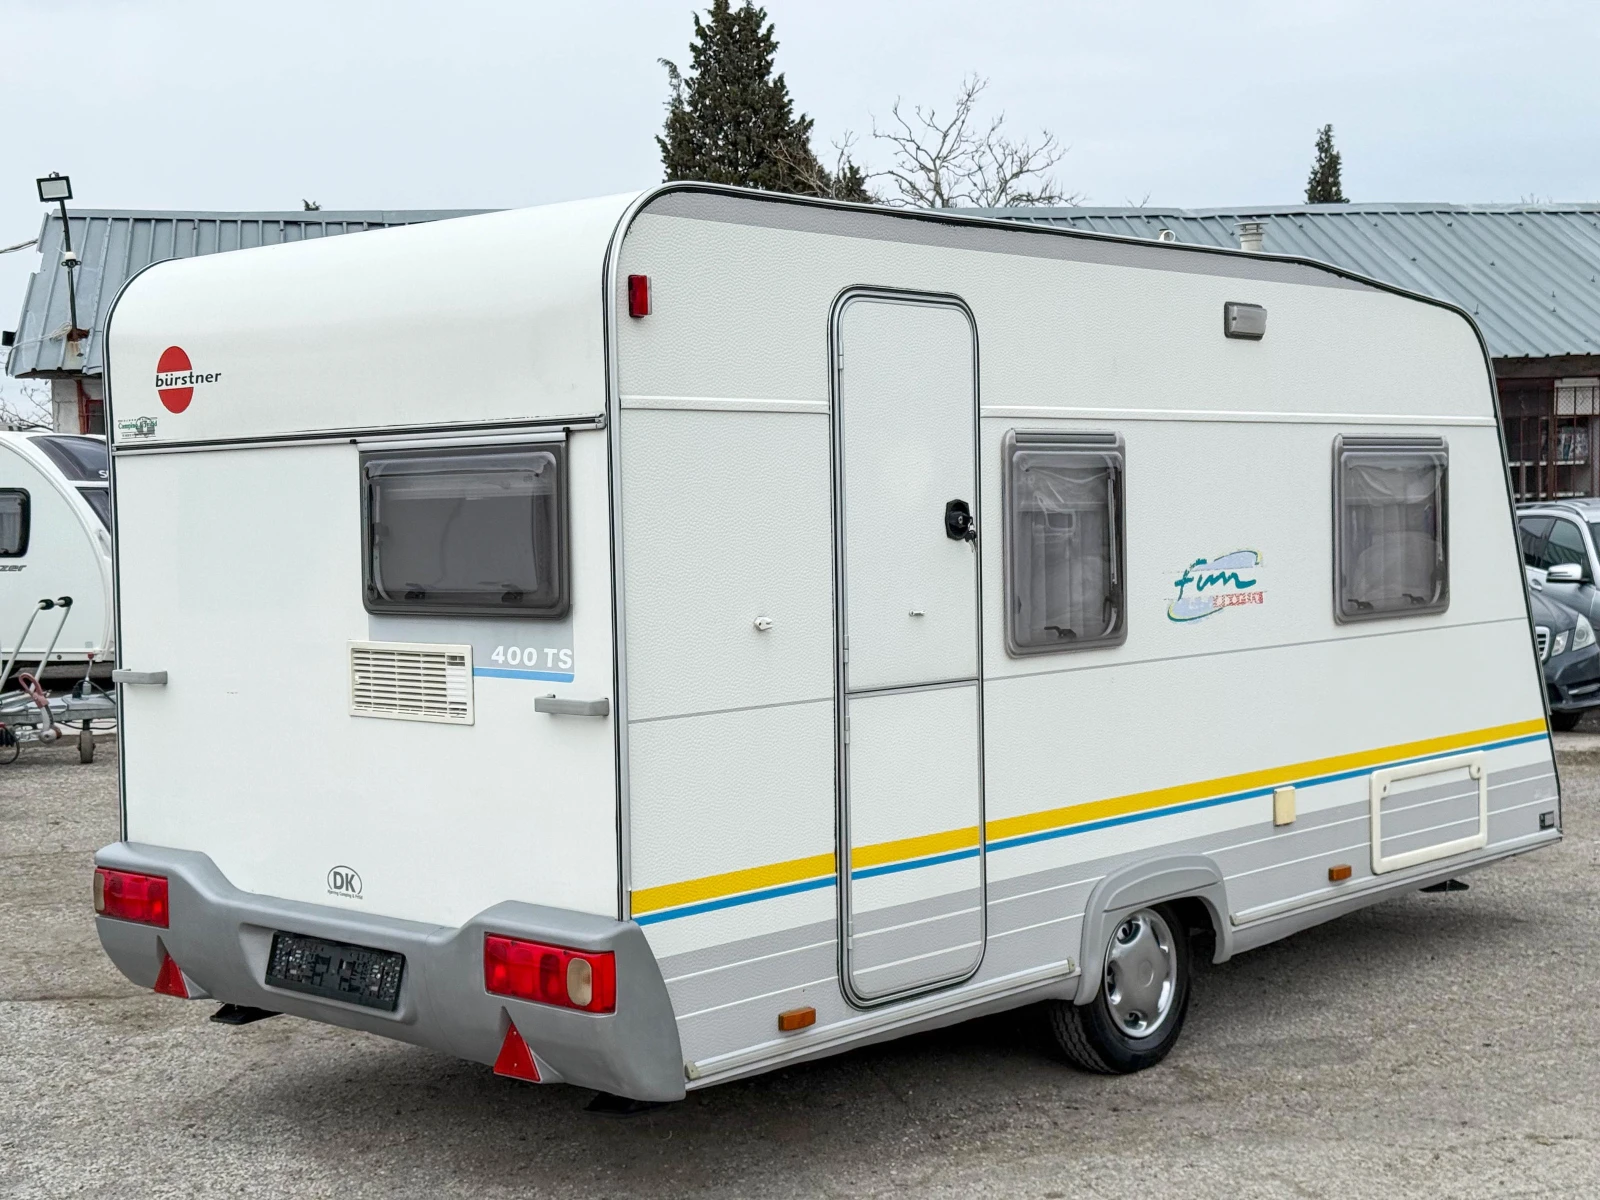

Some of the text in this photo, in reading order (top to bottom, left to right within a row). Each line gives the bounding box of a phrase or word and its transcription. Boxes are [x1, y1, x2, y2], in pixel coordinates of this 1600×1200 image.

[155, 371, 222, 388] bürstner
[1174, 558, 1257, 602] fun
[491, 645, 573, 670] 400 TS
[333, 870, 356, 893] DK
